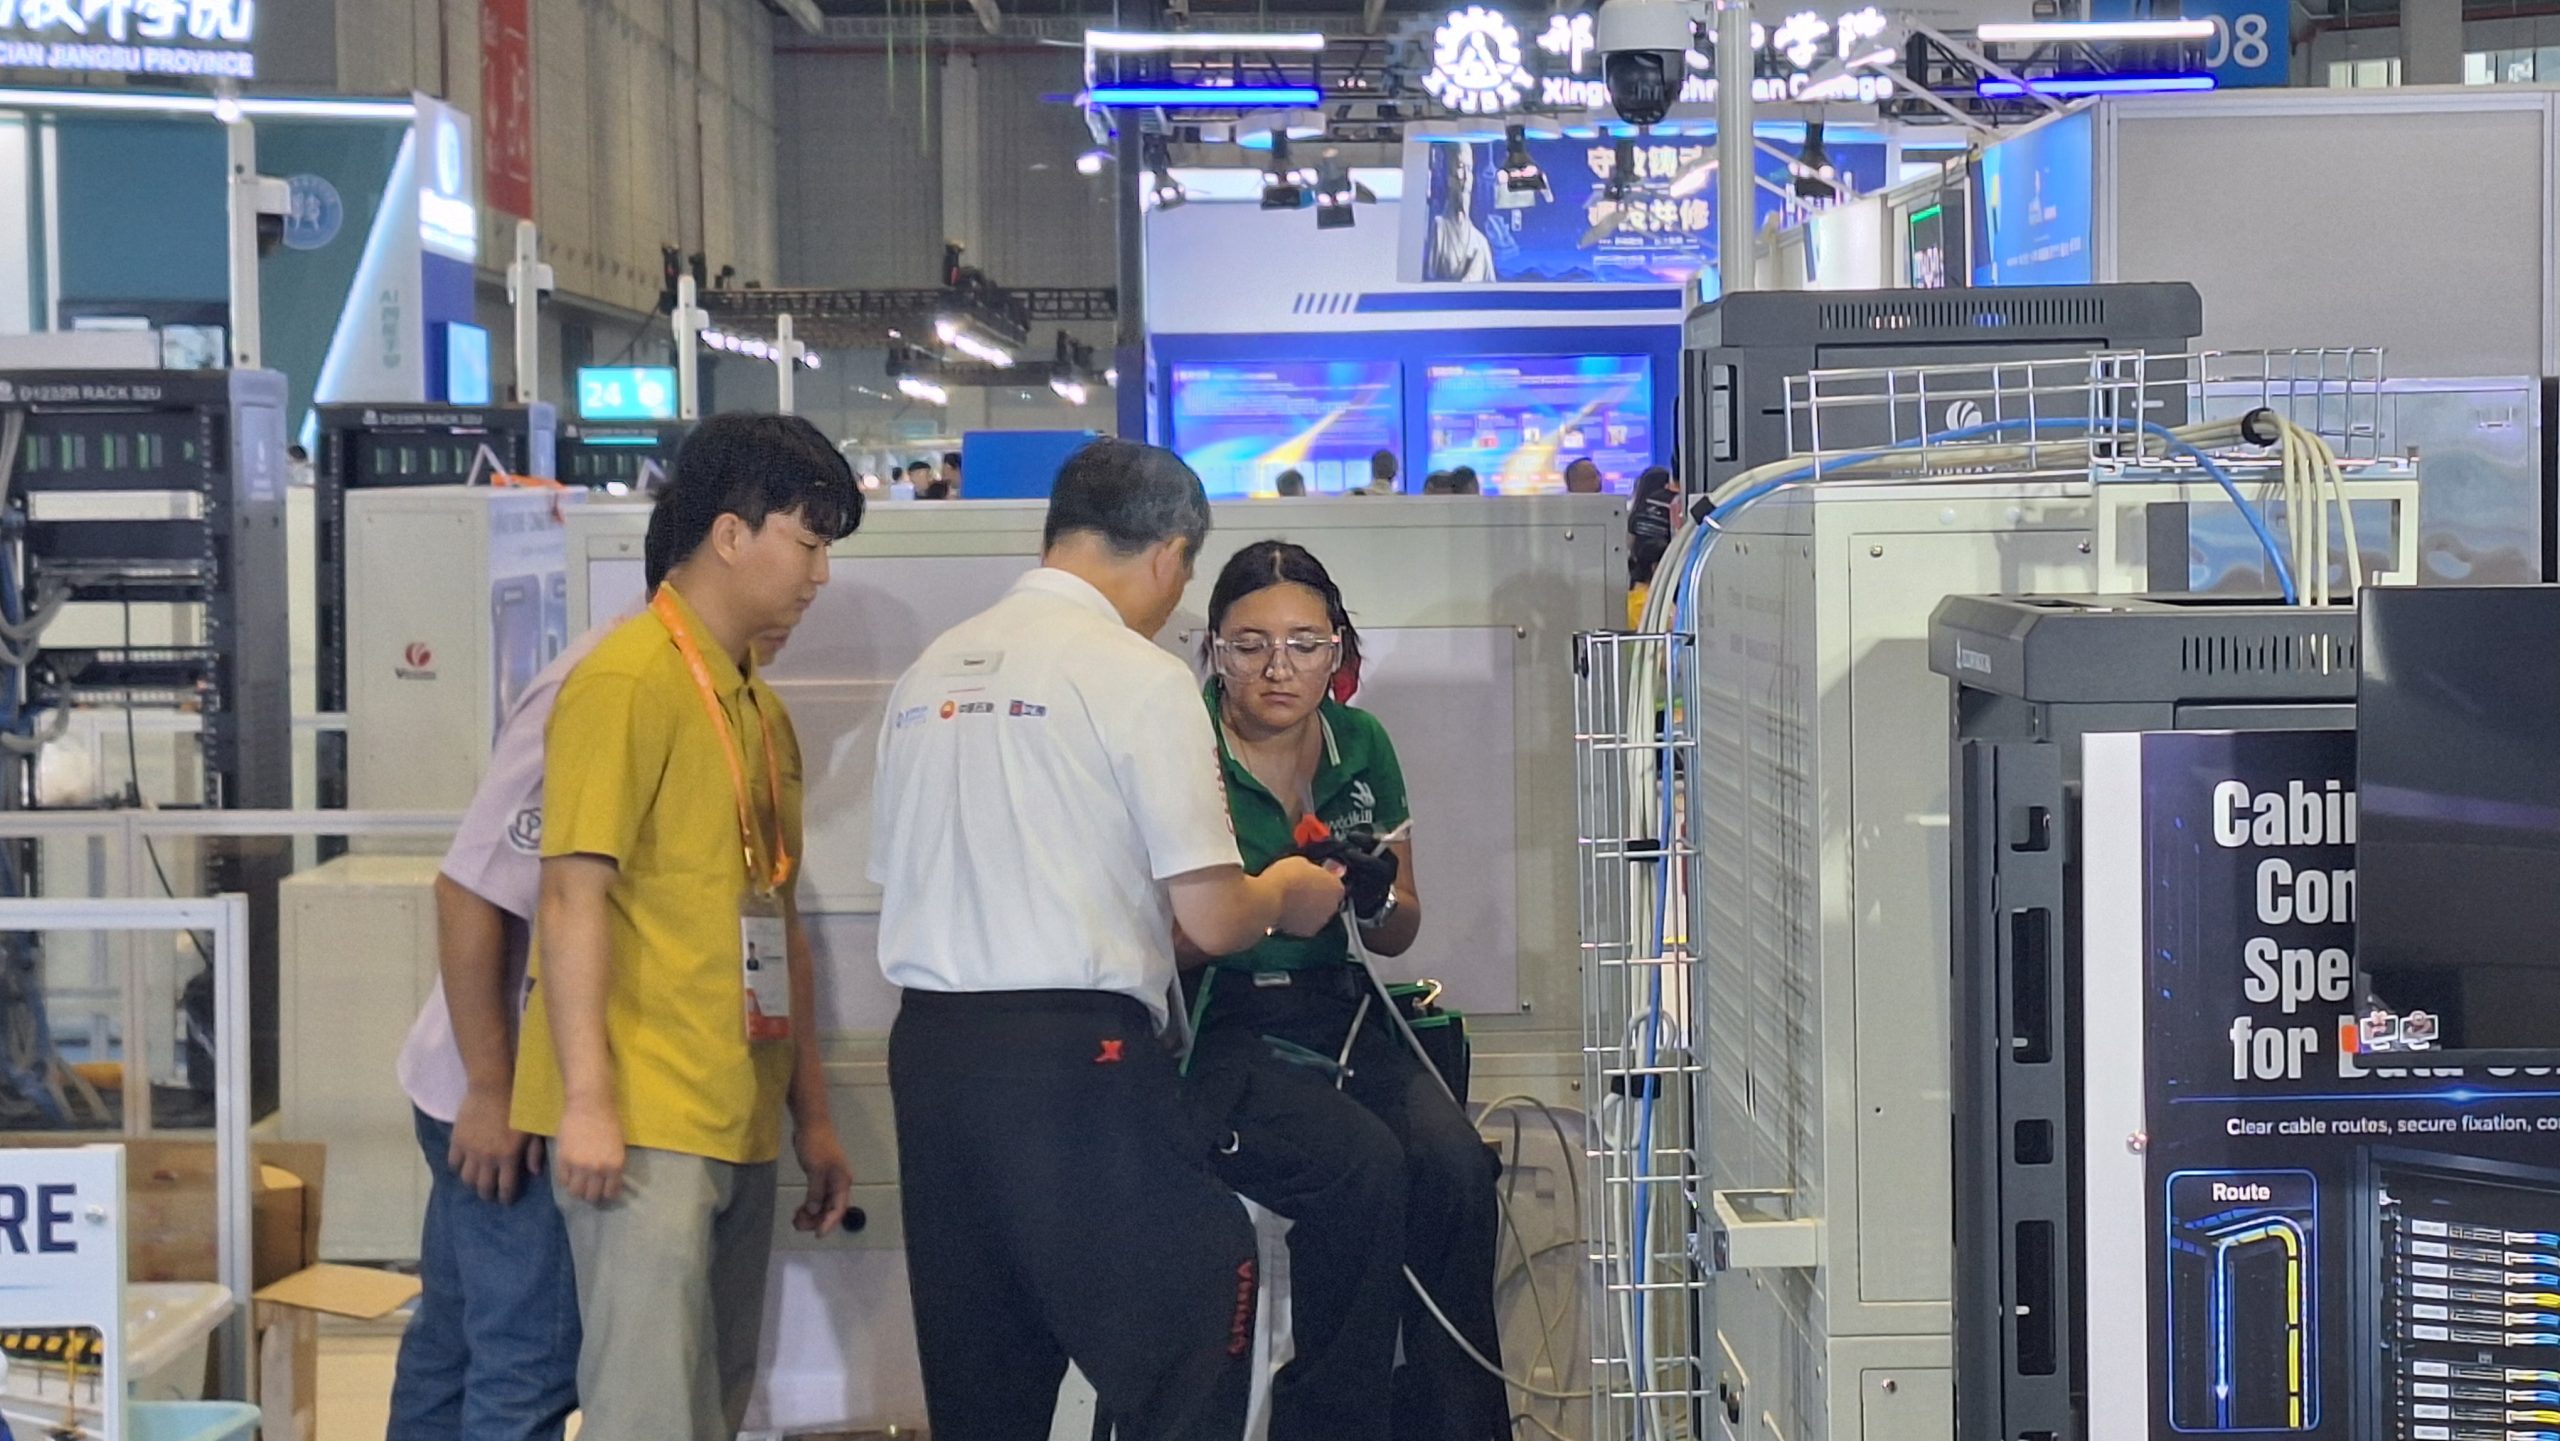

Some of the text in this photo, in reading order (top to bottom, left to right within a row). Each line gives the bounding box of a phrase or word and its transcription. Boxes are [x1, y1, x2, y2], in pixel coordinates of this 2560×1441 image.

[82, 385, 129, 400] RACK
[585, 382, 622, 409] 24
[2244, 937, 2355, 1013] Spe
[2229, 1016, 2319, 1080] for
[2226, 1118, 2273, 1135] Clear
[2278, 1117, 2326, 1134] cable
[2331, 1117, 2393, 1134] routes,
[2397, 1118, 2457, 1133] secure
[2461, 1114, 2532, 1132] fixation,
[2212, 1182, 2271, 1202] Route
[0, 1183, 78, 1254] RE
